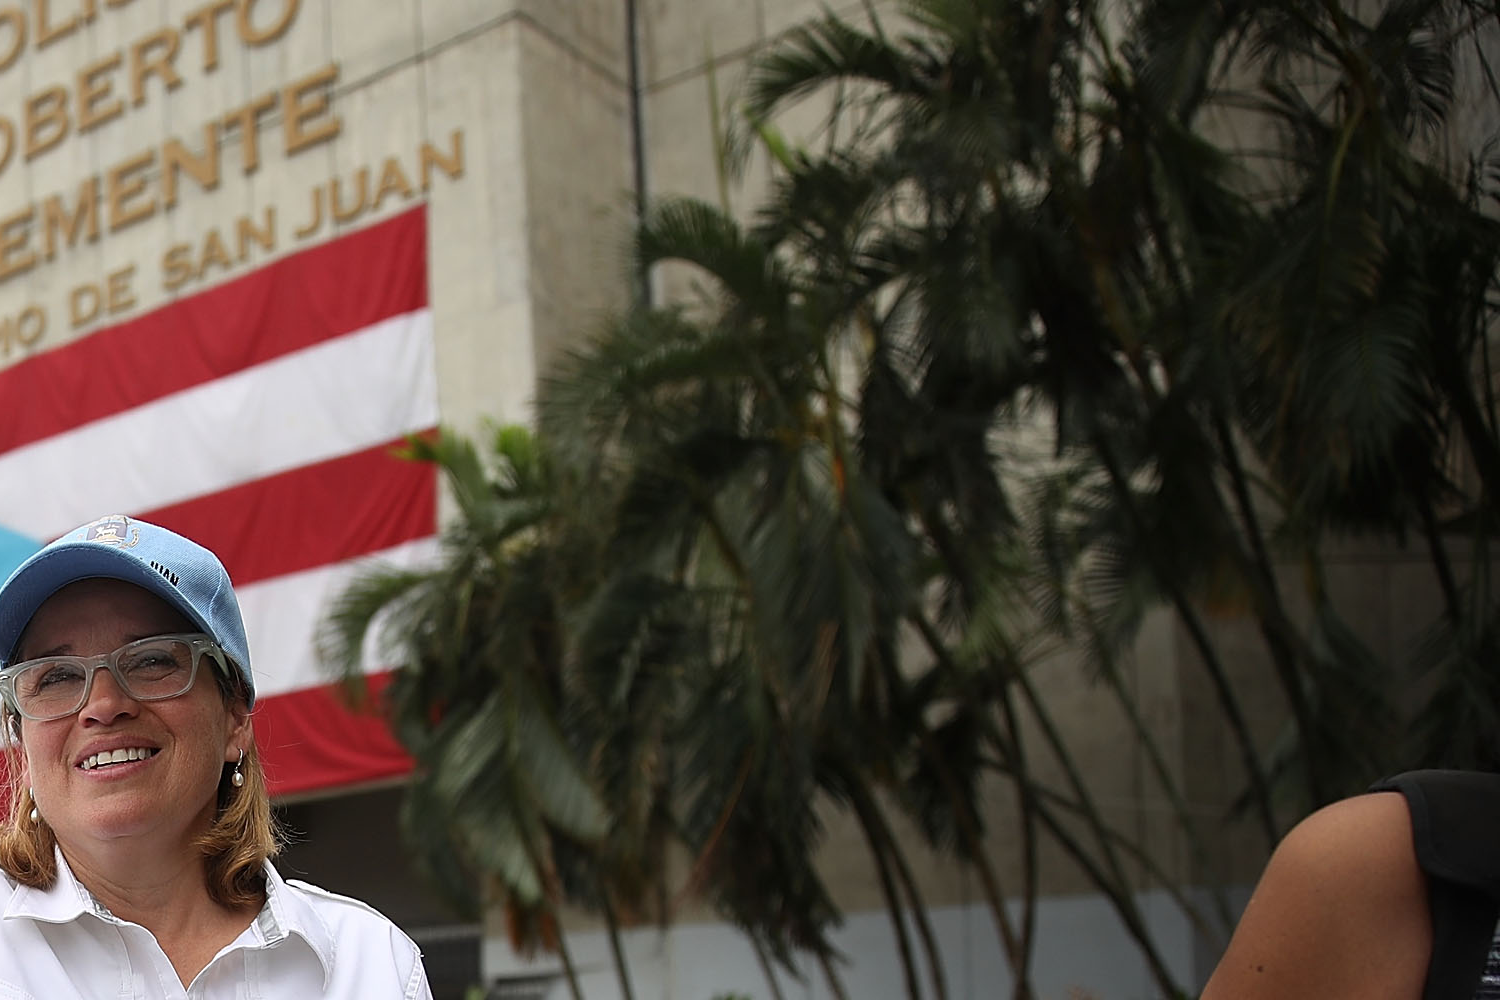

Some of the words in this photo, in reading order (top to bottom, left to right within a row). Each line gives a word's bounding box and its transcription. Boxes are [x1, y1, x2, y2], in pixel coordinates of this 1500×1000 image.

[69, 264, 137, 329] DE
[161, 205, 277, 291] SAN
[294, 130, 465, 240] JUAN
